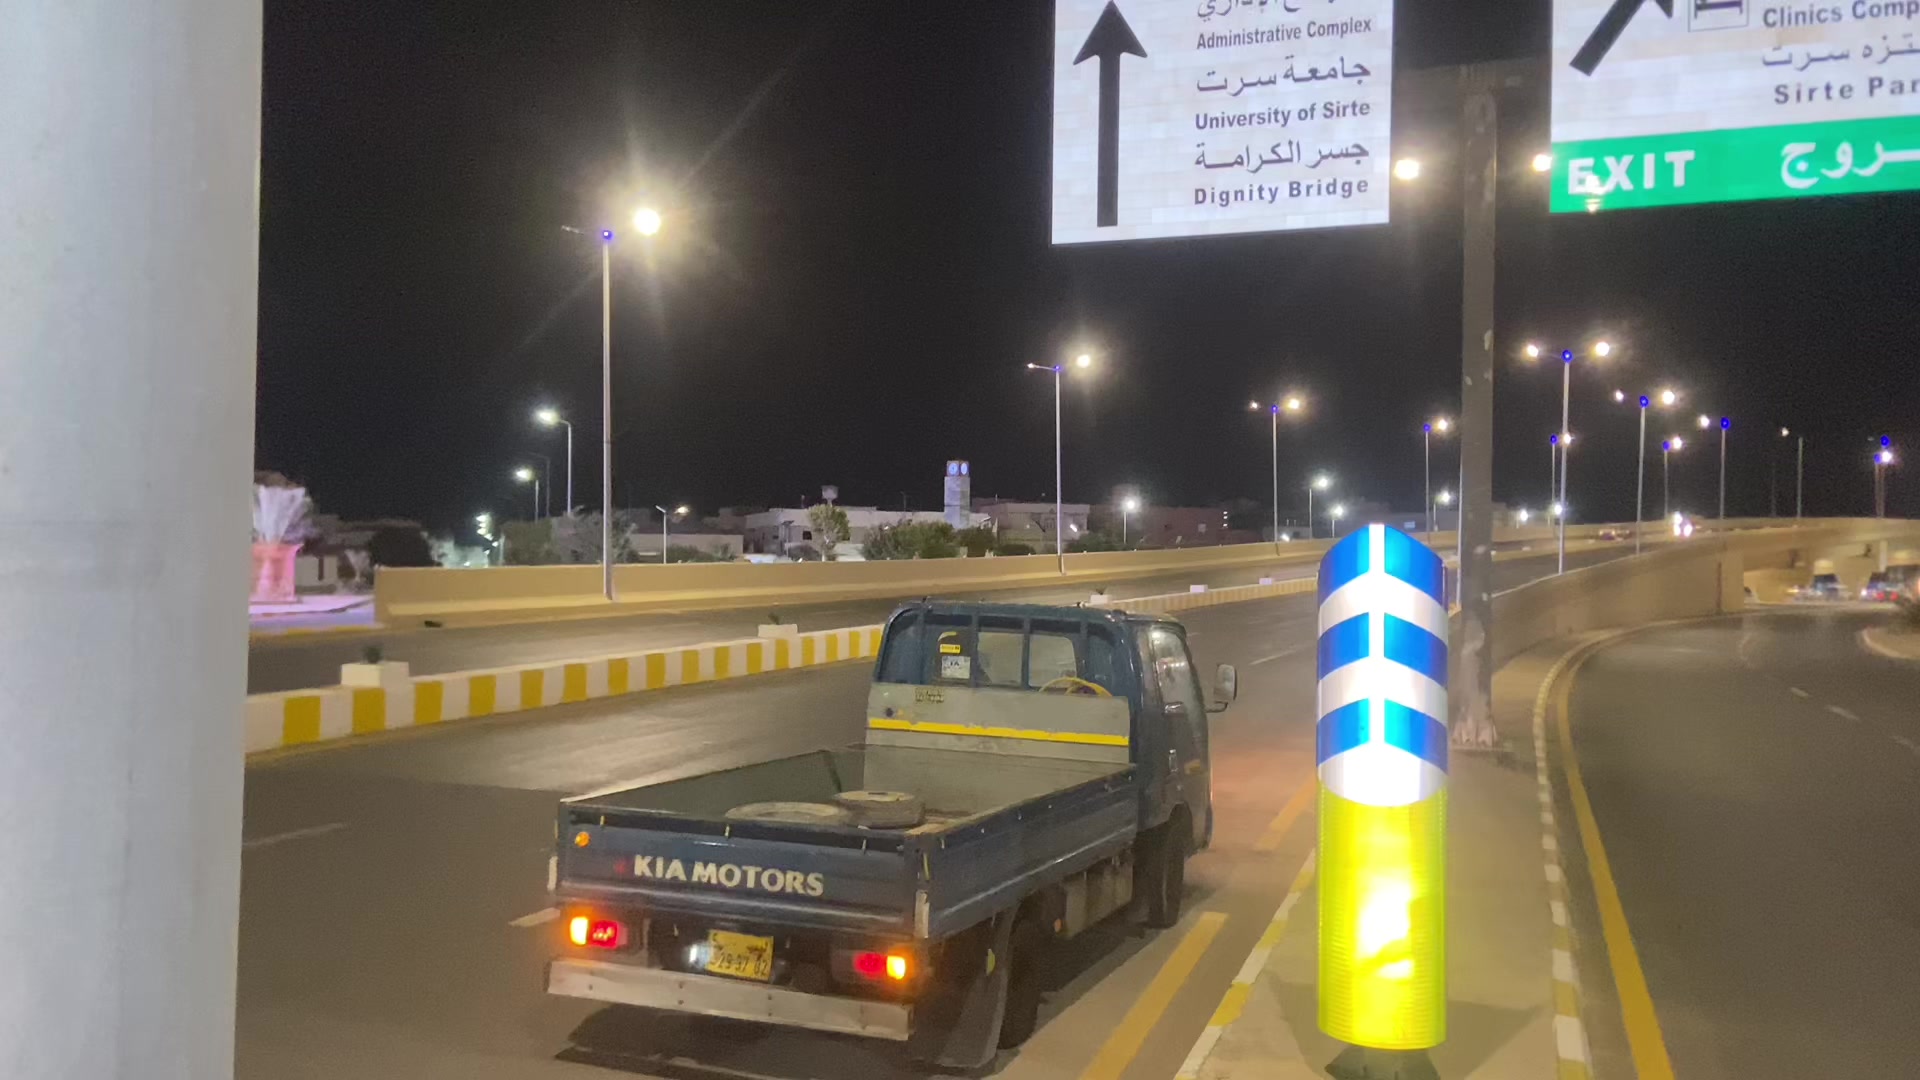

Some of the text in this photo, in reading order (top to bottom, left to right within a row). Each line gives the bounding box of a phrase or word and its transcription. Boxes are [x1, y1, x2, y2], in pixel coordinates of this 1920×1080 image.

[1762, 5, 1843, 28] Clinics
[1196, 17, 1372, 50] Administrative Complex
[1762, 46, 1850, 72] سرت
[1196, 55, 1371, 97] جامعة سرت
[1774, 81, 1854, 105] Sirte
[1195, 100, 1371, 129] University of Sirte
[1195, 139, 1370, 174] جسر الكرامة
[1567, 150, 1696, 196] EXIT
[1780, 140, 1920, 189] روج
[1194, 177, 1370, 208] Dignity Bridge
[633, 854, 824, 897] KIA MOTORS
